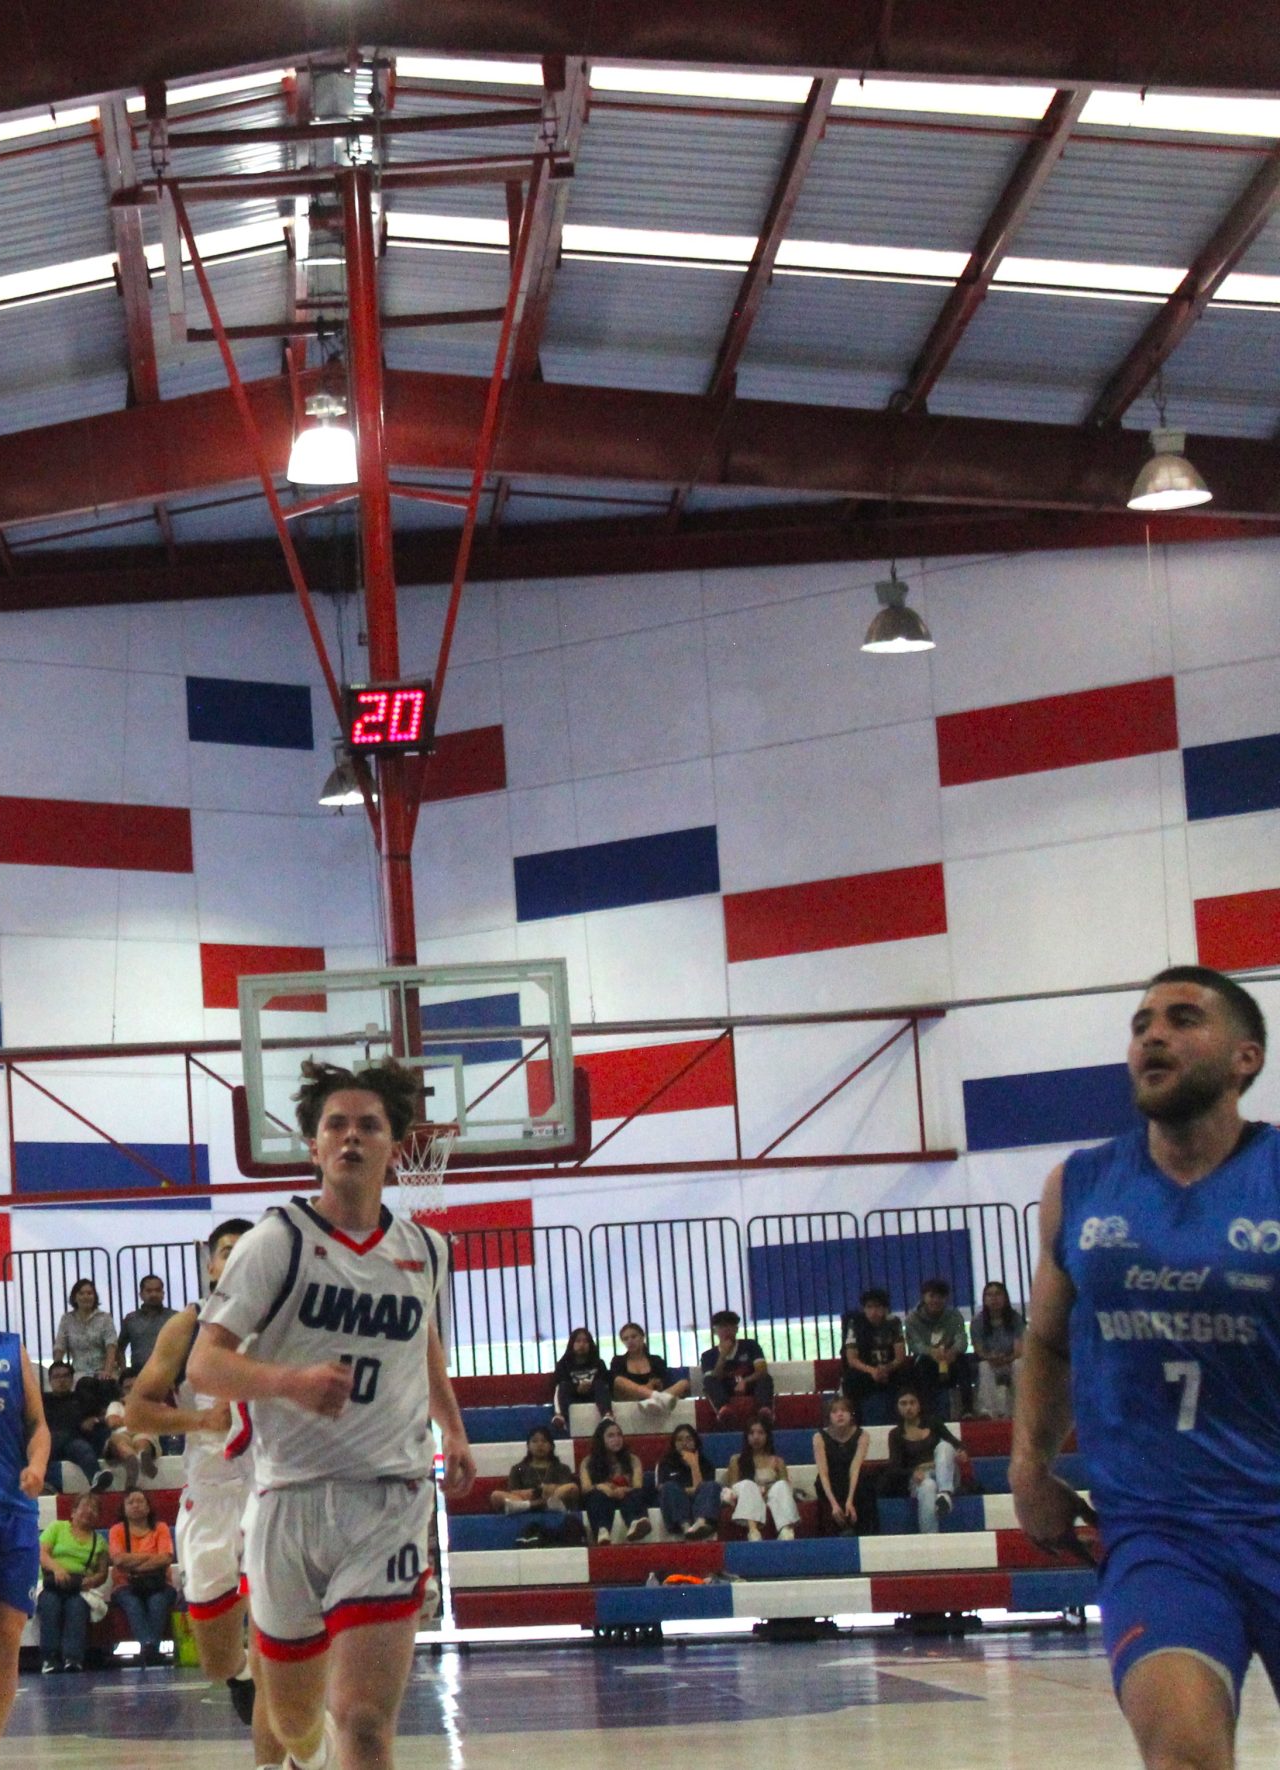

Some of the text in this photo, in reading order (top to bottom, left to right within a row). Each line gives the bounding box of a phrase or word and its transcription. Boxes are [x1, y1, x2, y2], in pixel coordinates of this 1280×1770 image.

[352, 690, 426, 744] 20
[1124, 1265, 1211, 1292] telcel
[298, 1282, 423, 1341] UMAD
[1095, 1311, 1258, 1344] BORREGOS
[339, 1354, 382, 1404] 0
[1163, 1361, 1201, 1432] 7
[387, 1543, 419, 1583] 10
